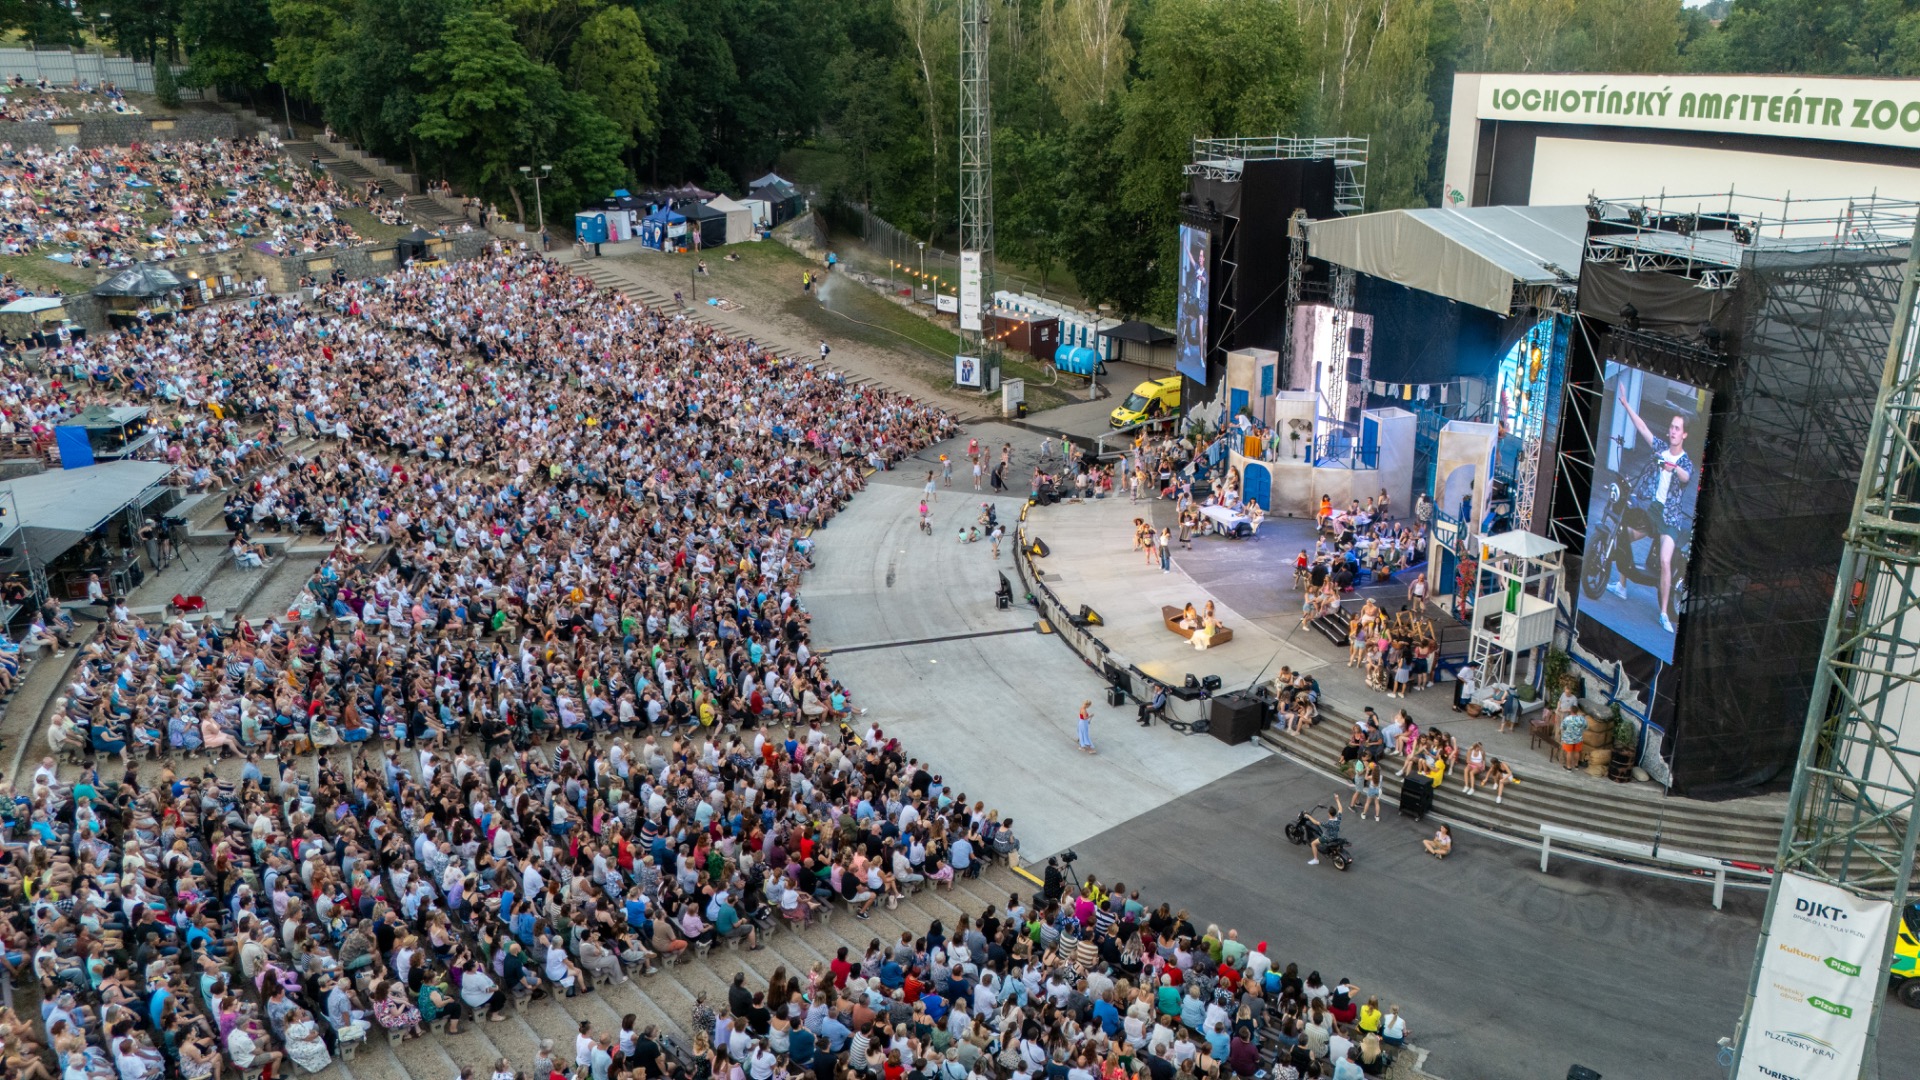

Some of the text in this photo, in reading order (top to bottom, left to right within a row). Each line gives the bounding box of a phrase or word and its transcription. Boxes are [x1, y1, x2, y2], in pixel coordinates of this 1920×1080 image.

[1492, 84, 1920, 133] LOCHOTÍNSKÝ AMFITEÁTR ZOO
[1779, 943, 1858, 975] Kulturní Plzeň
[1814, 999, 1849, 1016] Plzeň 1
[1812, 1047, 1835, 1060] KRAJ
